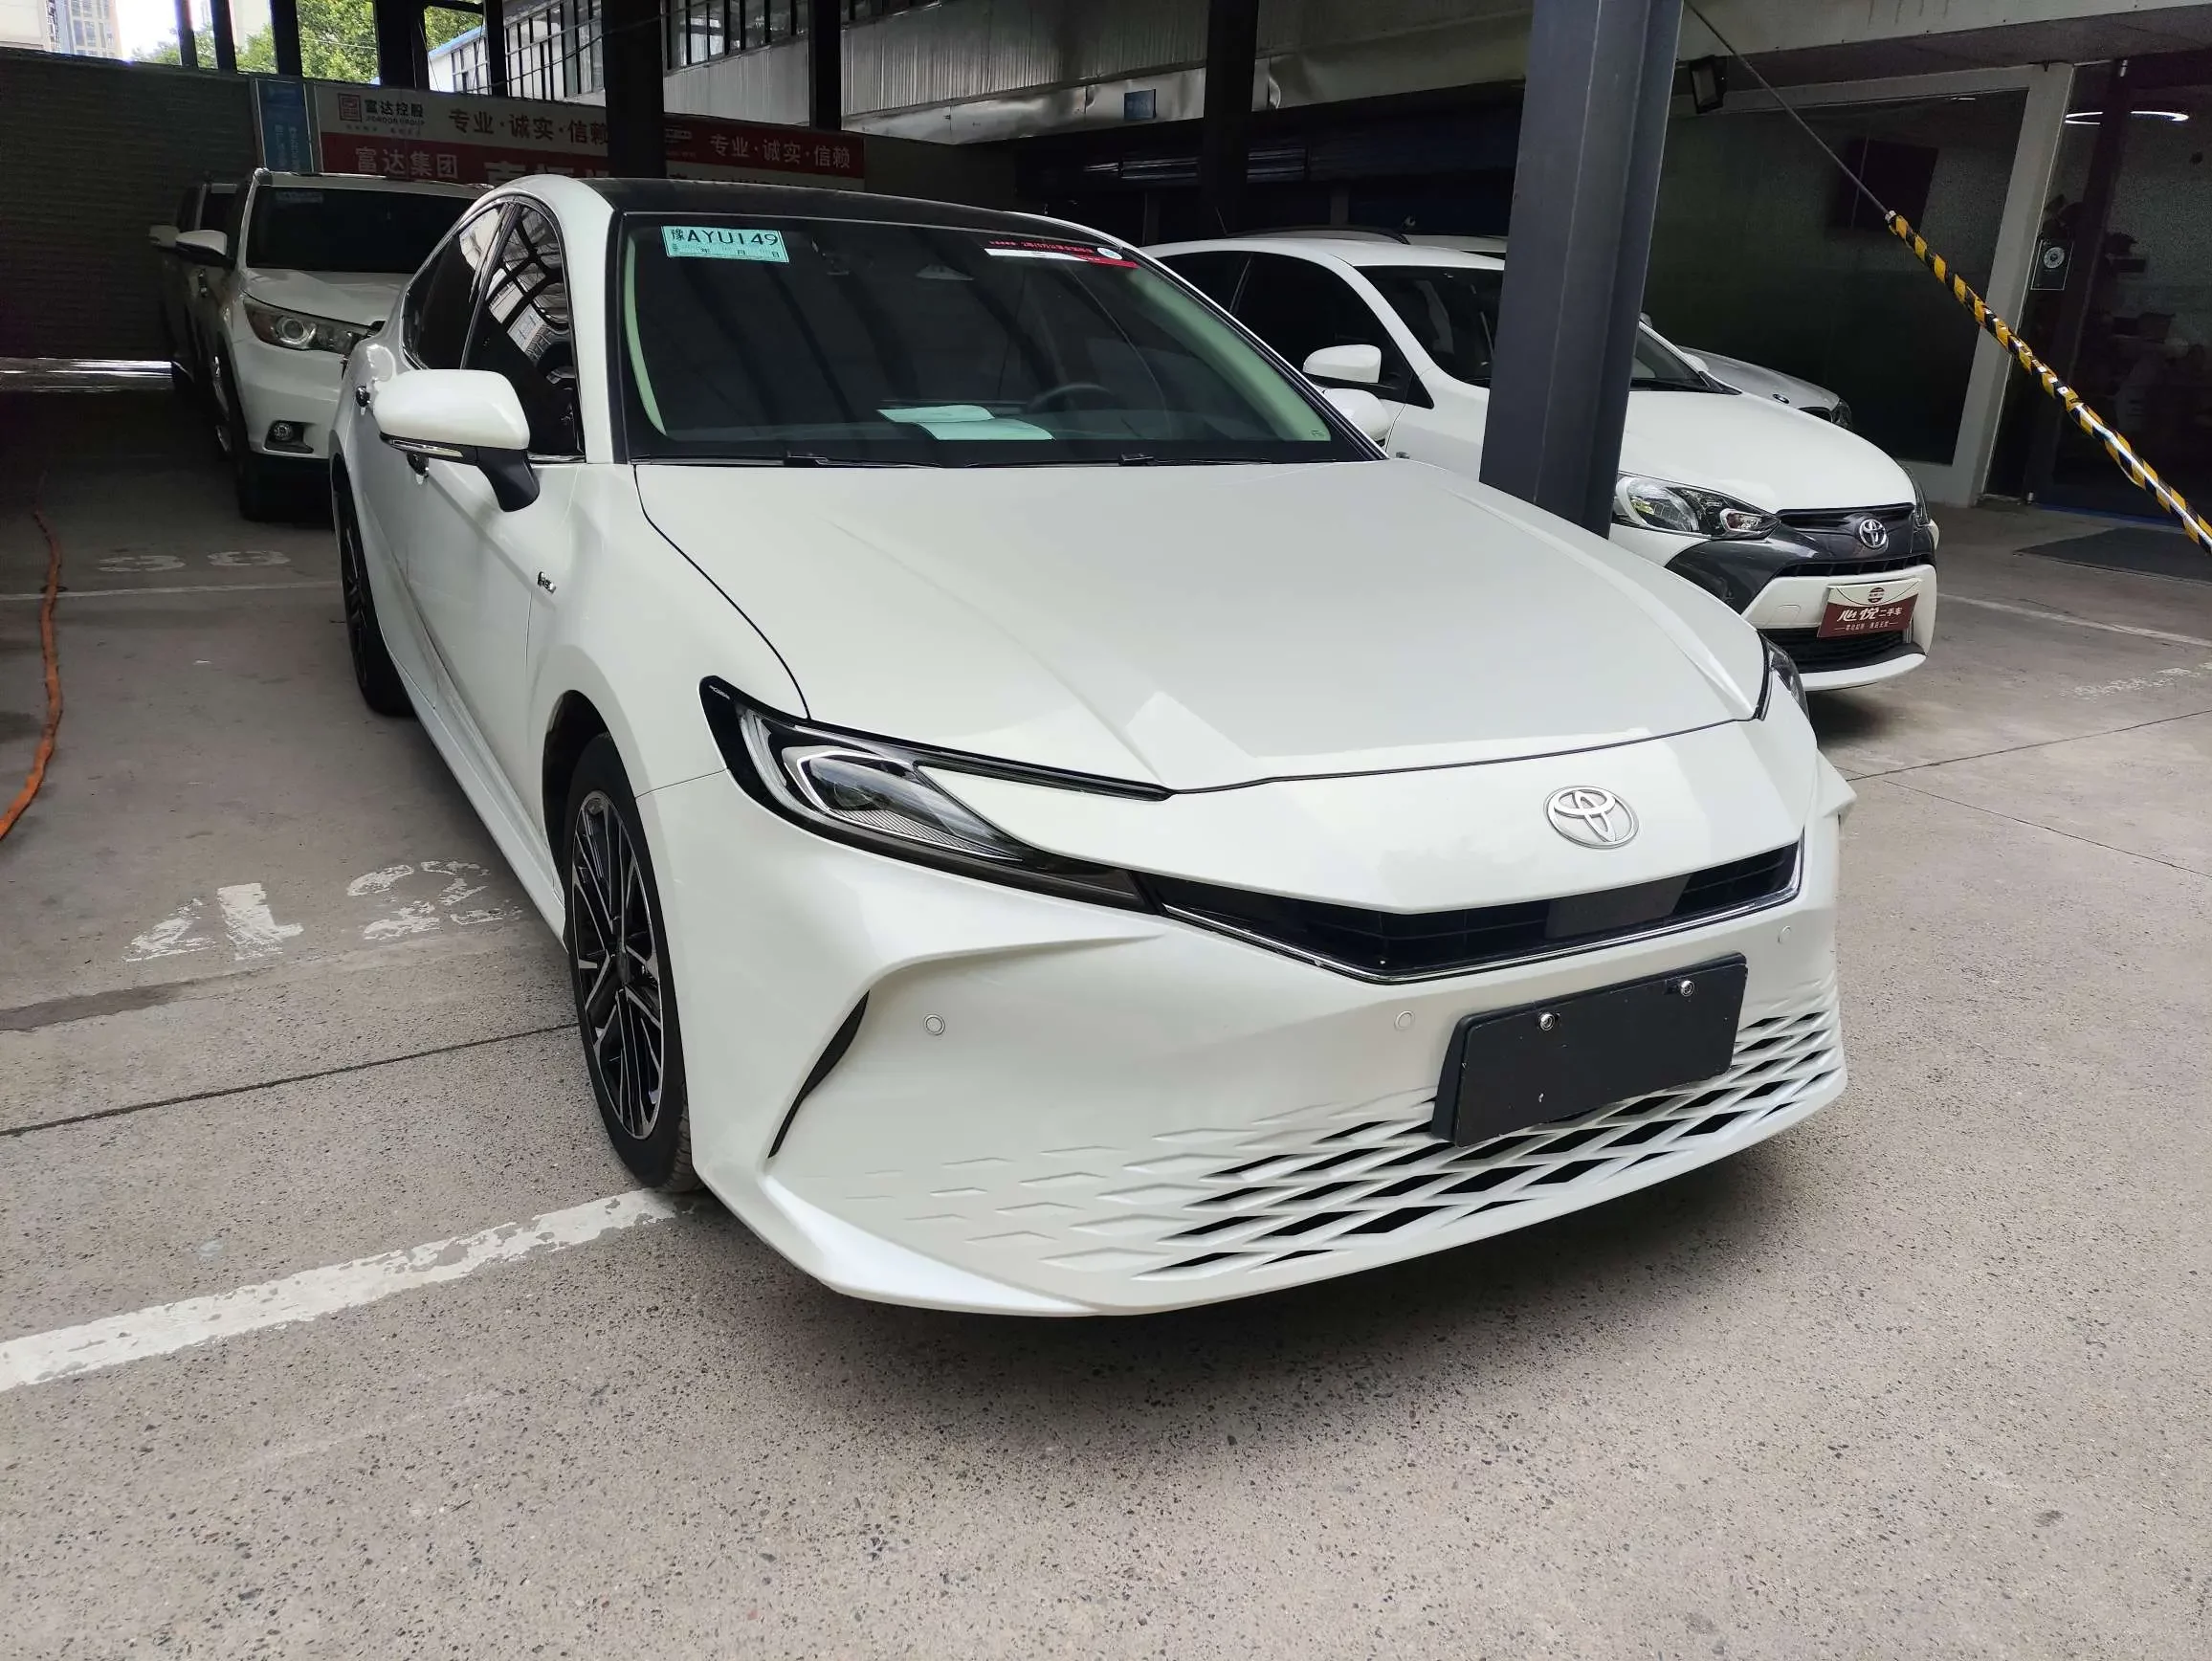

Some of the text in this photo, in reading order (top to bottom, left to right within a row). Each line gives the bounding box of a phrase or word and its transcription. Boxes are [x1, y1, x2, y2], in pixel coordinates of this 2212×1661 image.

[365, 100, 424, 118] 富达控股
[355, 146, 459, 180] 富达集团
